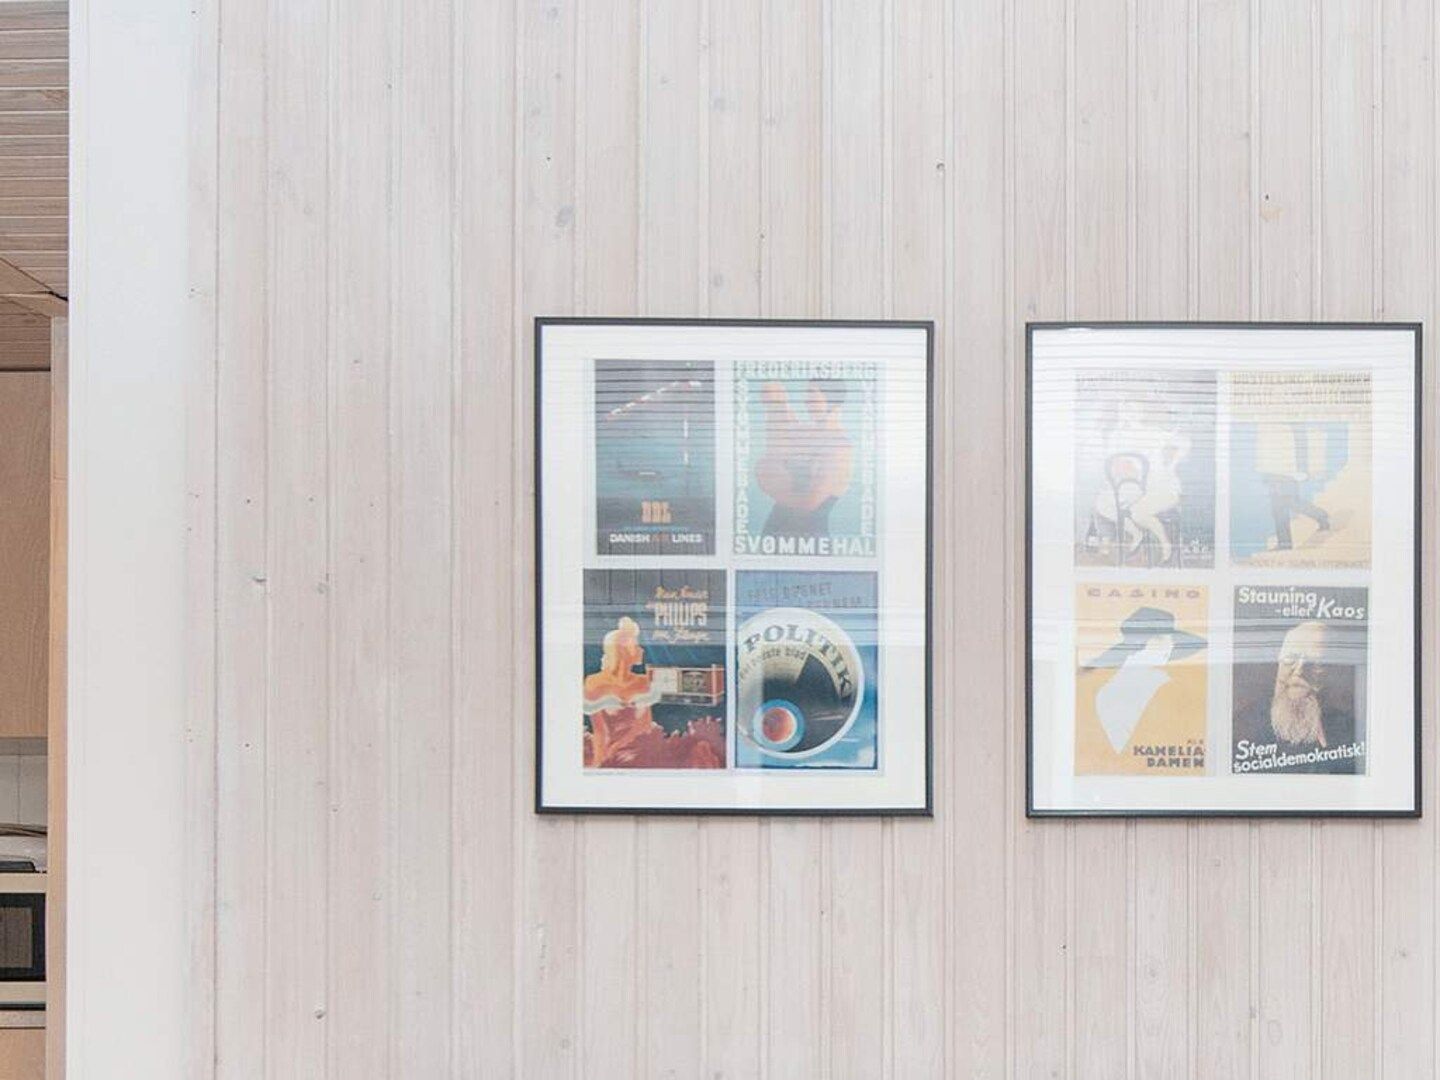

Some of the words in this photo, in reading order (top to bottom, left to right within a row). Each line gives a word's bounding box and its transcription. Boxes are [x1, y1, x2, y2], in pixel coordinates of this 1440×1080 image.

[609, 534, 650, 544] DANISH
[672, 534, 703, 544] LINES
[734, 535, 875, 554] SVØMMEHAL
[1087, 588, 1201, 599] CASINO
[1238, 587, 1317, 608] Stauning
[655, 602, 708, 626] PHILIPS
[1316, 598, 1365, 620] Kaos
[1233, 742, 1364, 773] socialdemokratisk!
[1236, 740, 1278, 760] Stem
[1147, 757, 1204, 768] DAMEN
